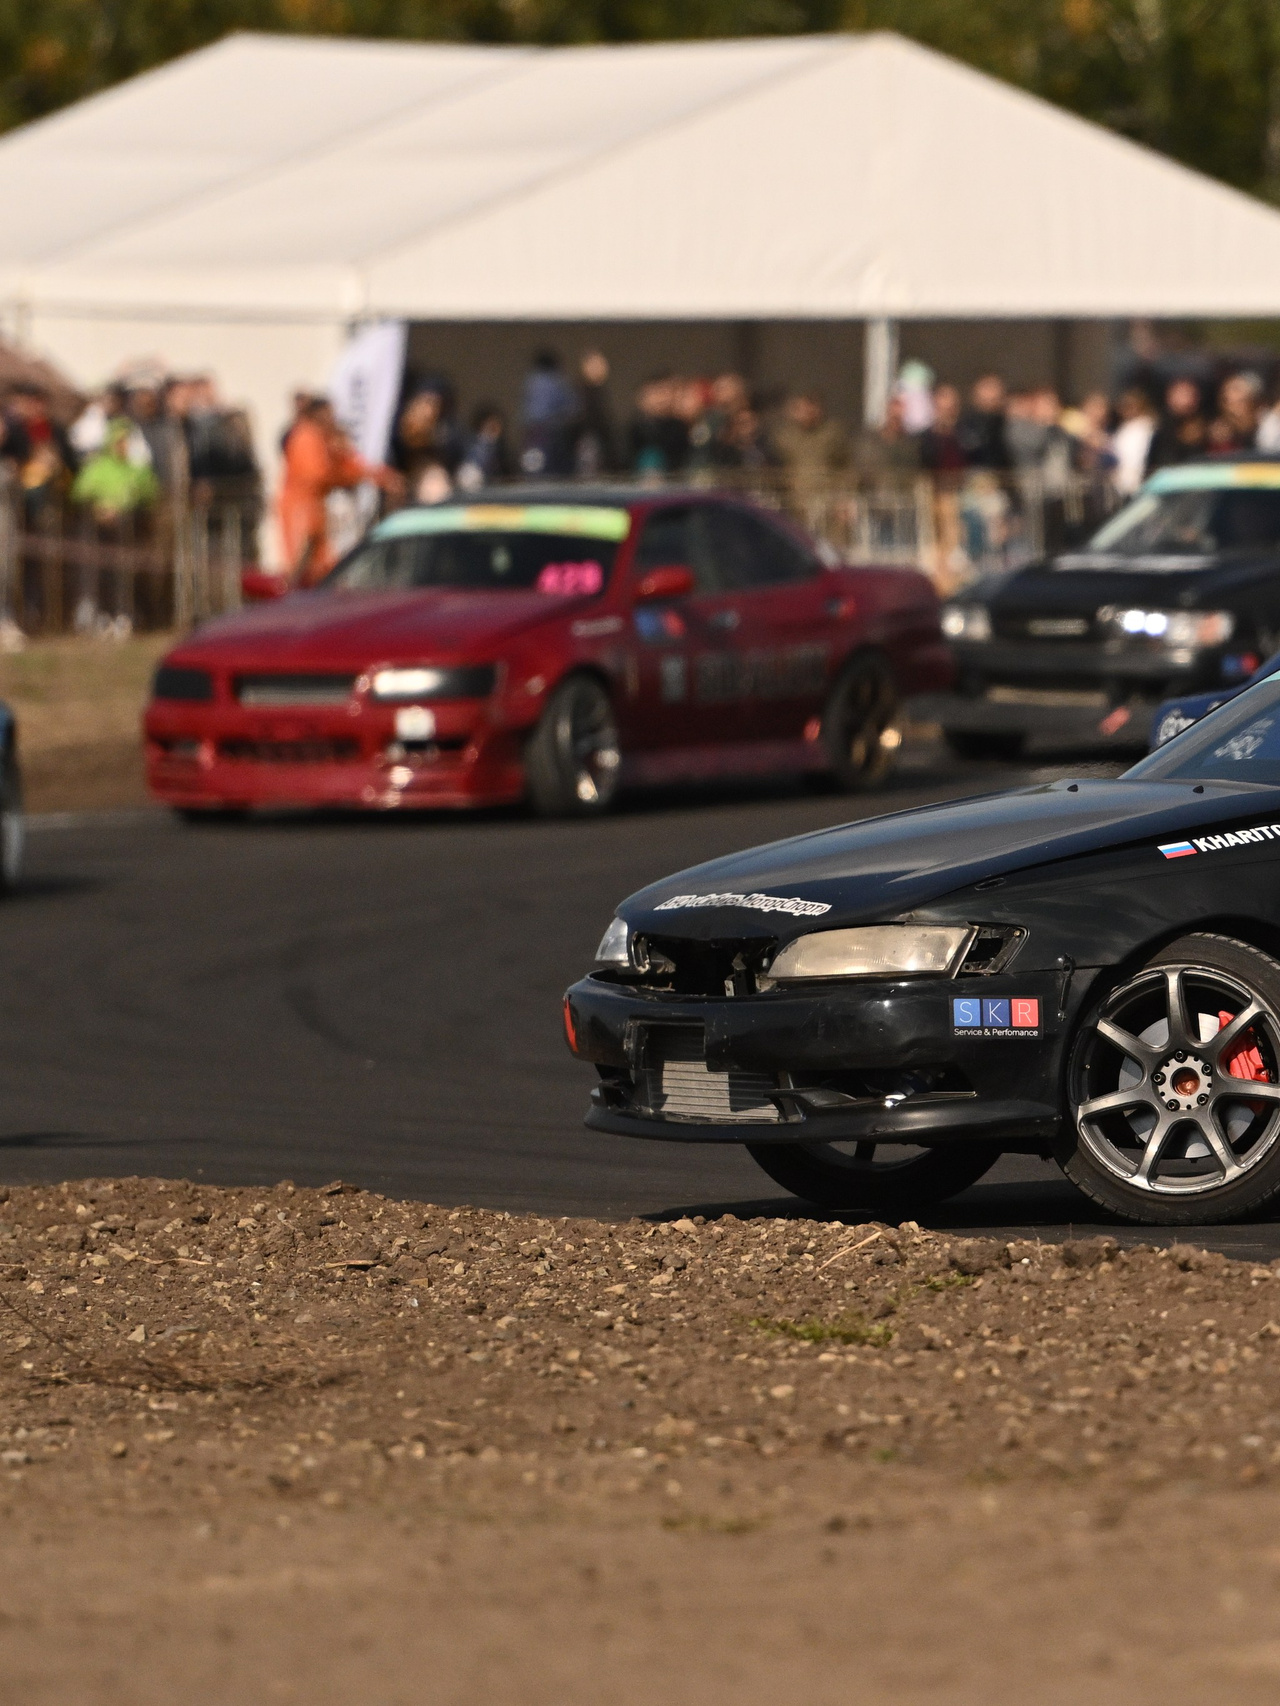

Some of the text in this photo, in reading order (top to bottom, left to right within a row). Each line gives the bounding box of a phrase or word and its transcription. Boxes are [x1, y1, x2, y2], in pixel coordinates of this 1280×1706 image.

[959, 1001, 1032, 1023] SKR
[954, 1028, 1038, 1037] Service & Perfomance
